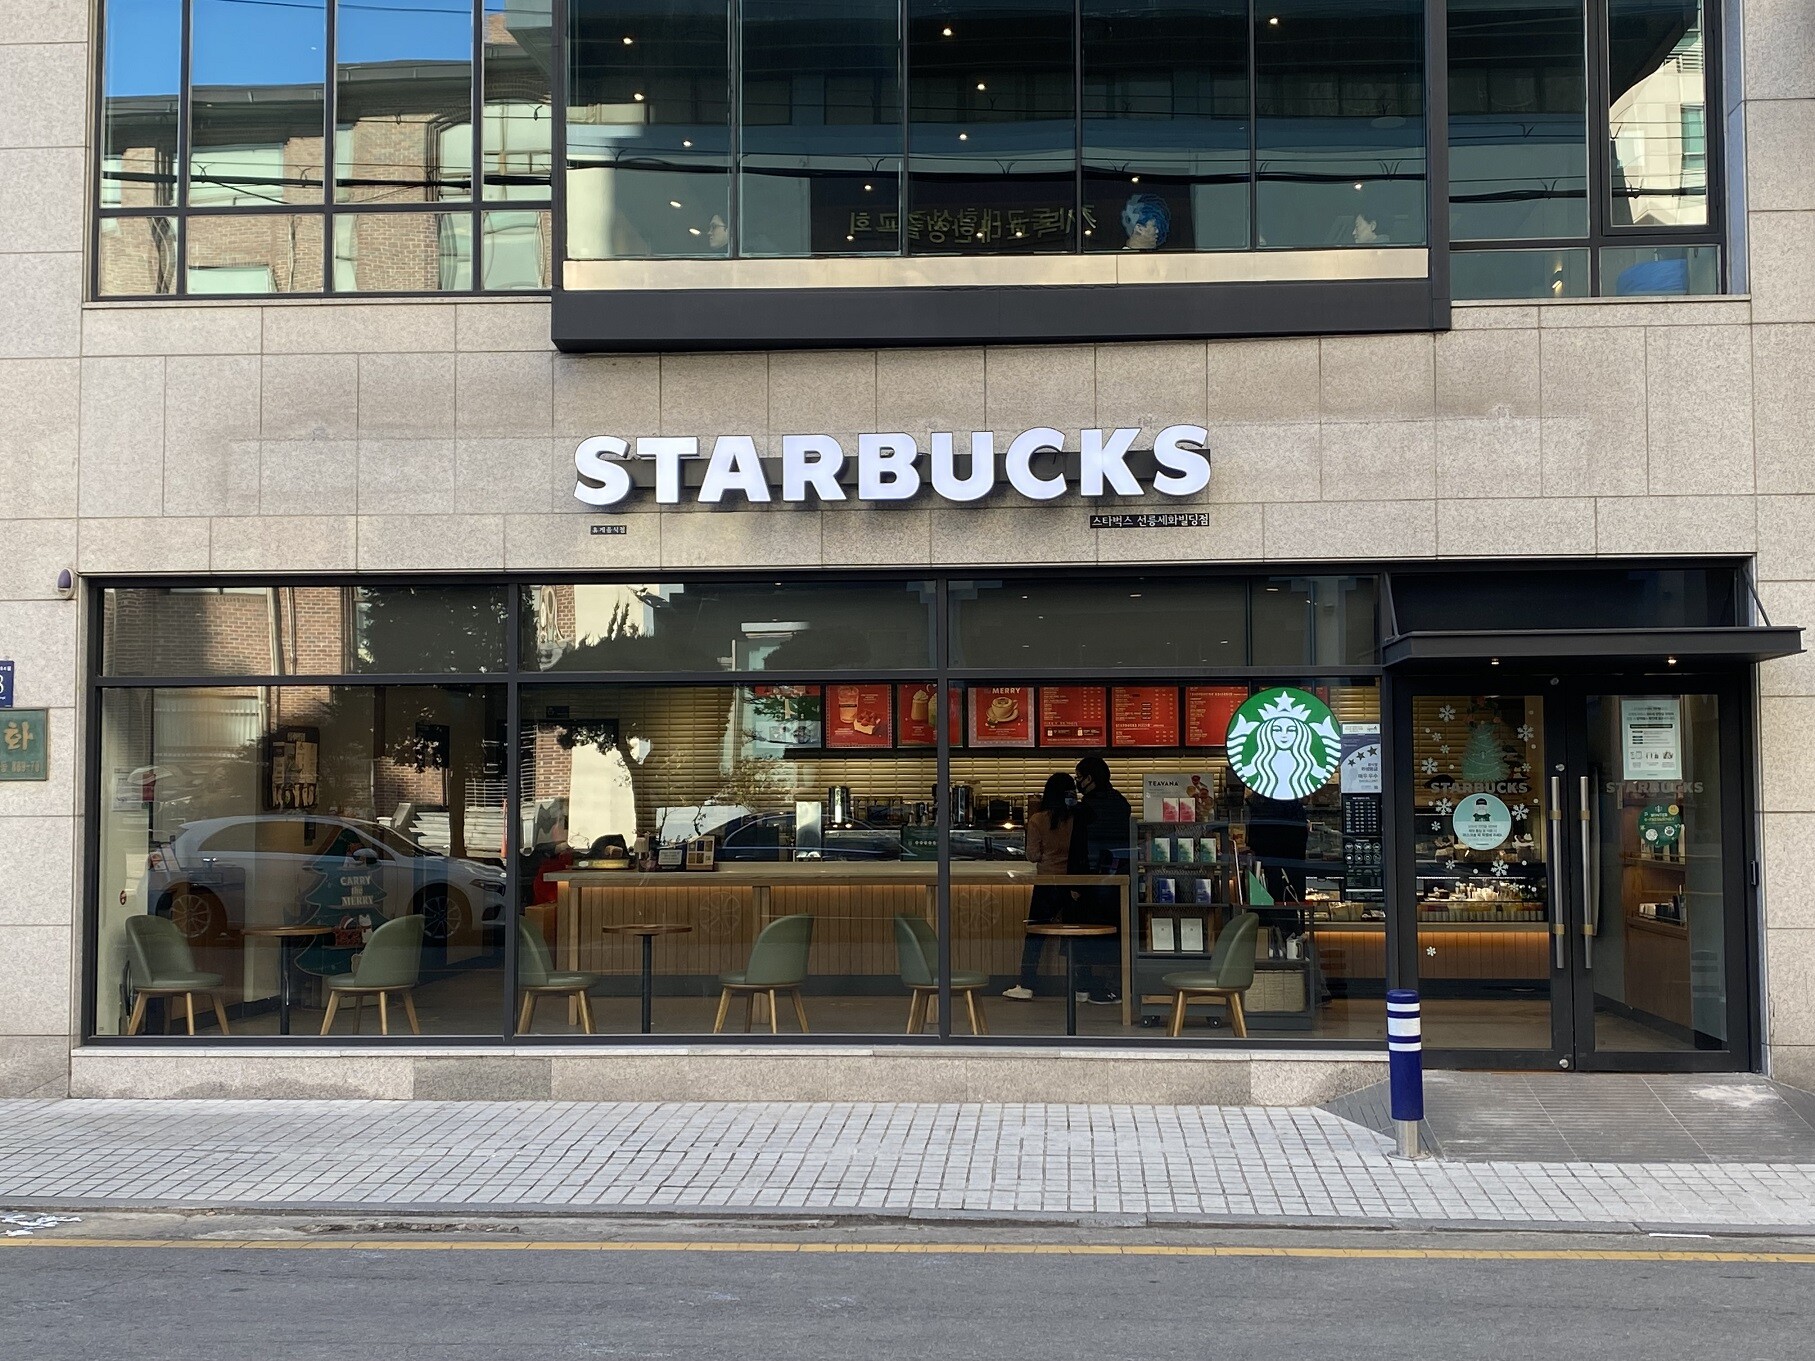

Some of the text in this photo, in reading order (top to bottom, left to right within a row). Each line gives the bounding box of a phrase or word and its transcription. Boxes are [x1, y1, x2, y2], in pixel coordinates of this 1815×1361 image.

[573, 424, 1212, 507] STARBUCKS
[1092, 513, 1209, 527] 스타벅스 선릉세화빌딩점
[992, 687, 1021, 695] MERRY
[1430, 782, 1528, 794] STARBUCKS
[1606, 781, 1704, 793] STARBUCKS
[340, 875, 371, 886] CARRY
[351, 886, 364, 895] the
[341, 896, 374, 906] MERRY
